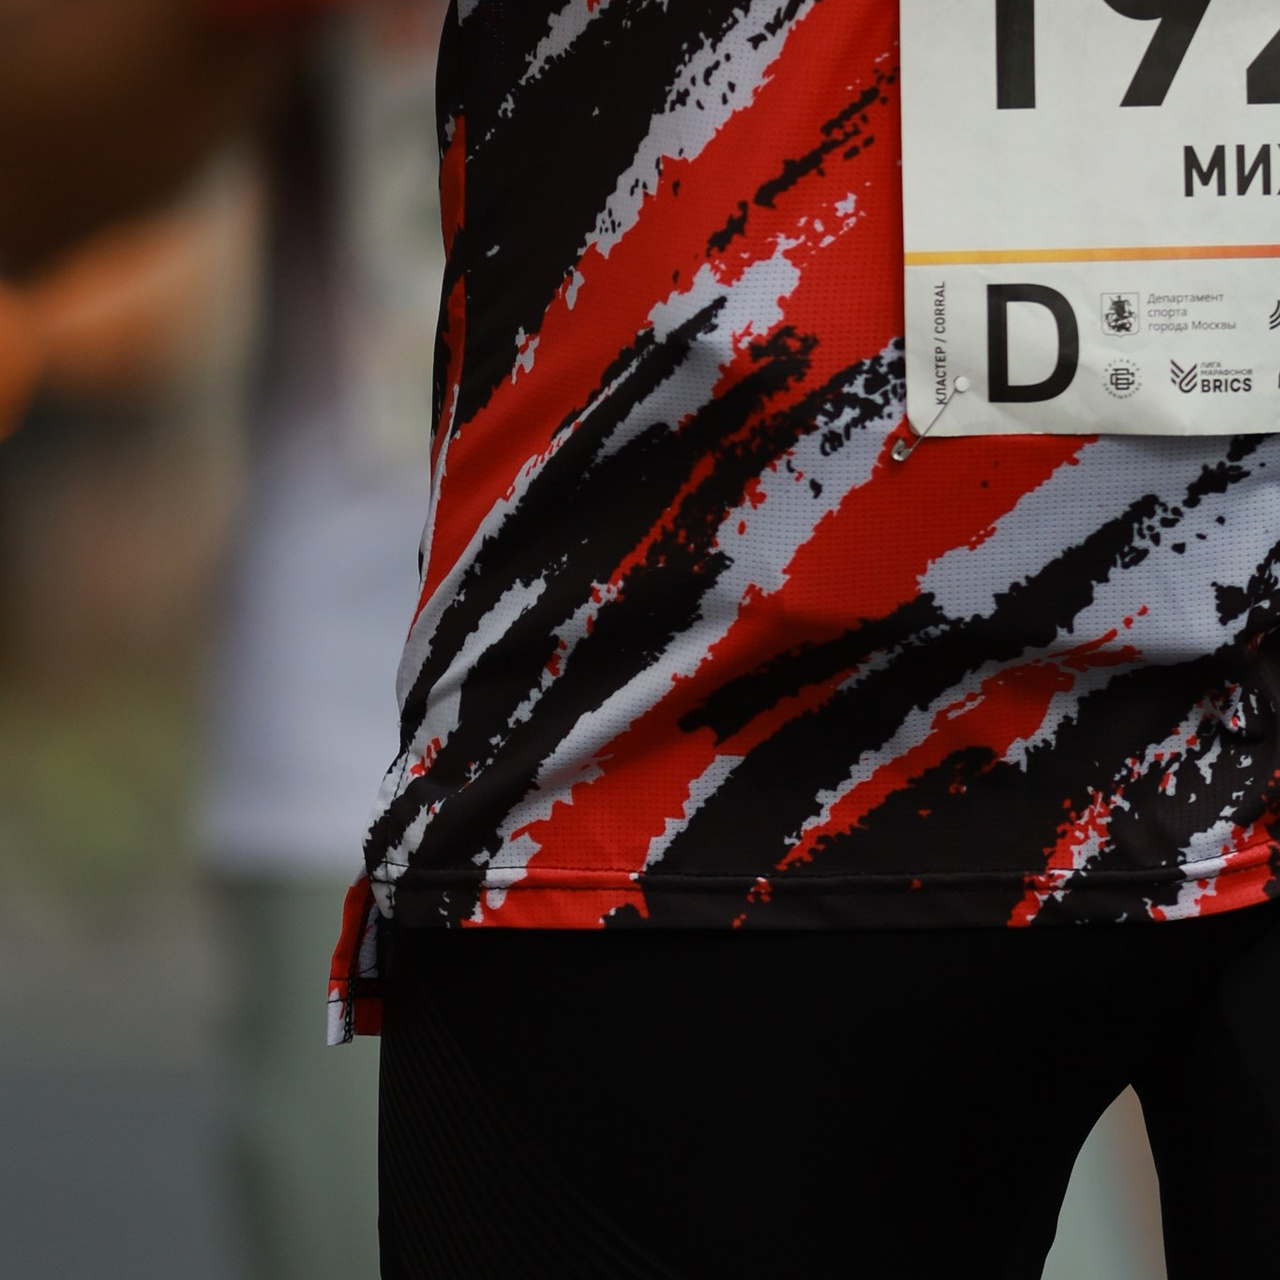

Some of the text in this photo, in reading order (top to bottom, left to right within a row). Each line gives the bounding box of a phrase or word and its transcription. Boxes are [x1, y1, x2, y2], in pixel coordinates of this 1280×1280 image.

[1147, 293, 1224, 305] Департамент
[934, 281, 946, 334] CORRAL
[1147, 308, 1187, 319] спорта
[1148, 320, 1236, 333] города Москвы
[987, 283, 1079, 403] D
[934, 346, 947, 405] КЛАСТЕР
[1201, 377, 1252, 393] BRICS
